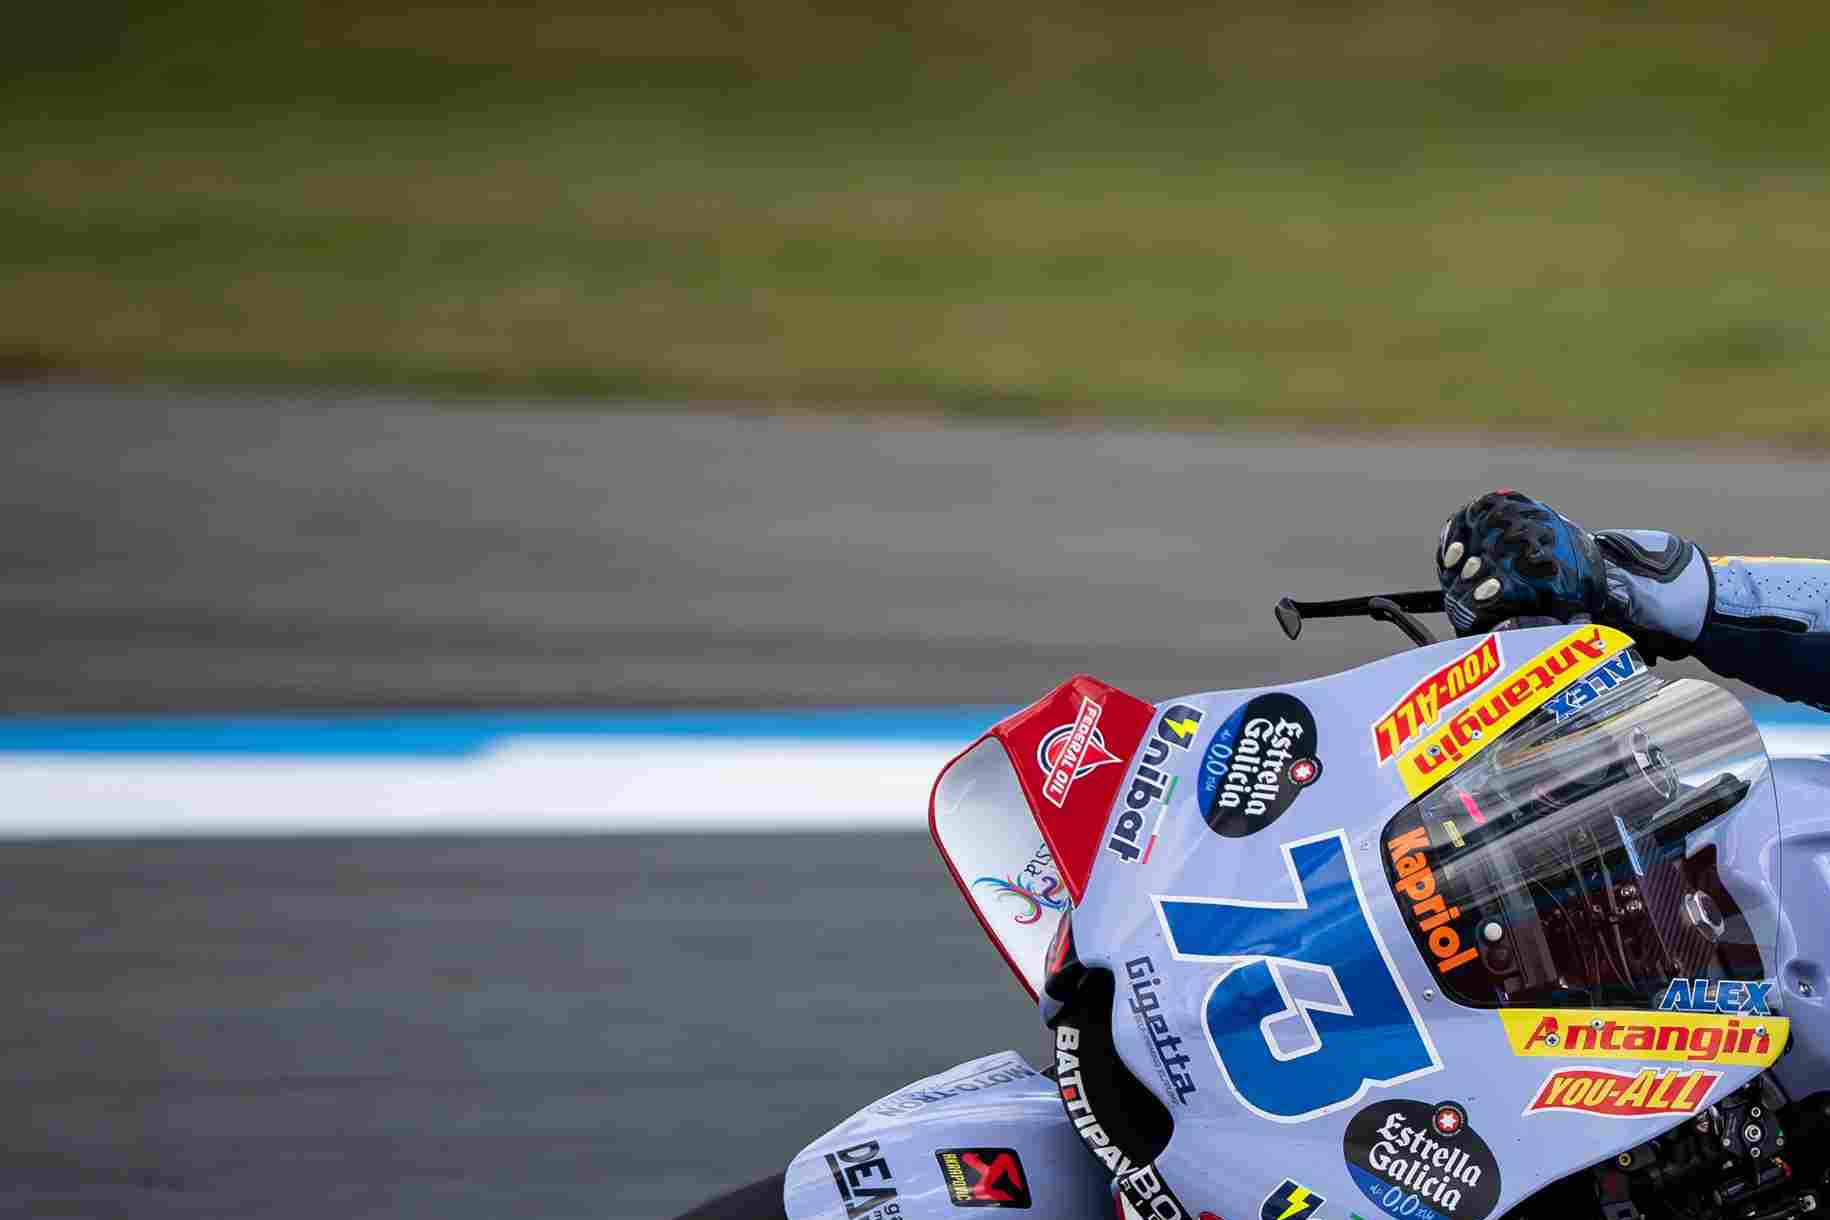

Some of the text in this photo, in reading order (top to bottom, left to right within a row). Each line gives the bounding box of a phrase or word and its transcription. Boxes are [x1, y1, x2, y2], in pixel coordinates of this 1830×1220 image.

[1378, 644, 1499, 755] YOU-ALL
[1413, 629, 1606, 775] Antangin
[1049, 707, 1098, 797] FEDERAL OIL
[1105, 703, 1206, 863] Unibat
[1218, 717, 1274, 809] Galicia
[1247, 716, 1304, 815] Estrella
[1387, 826, 1479, 974] Kapriol
[1150, 828, 1445, 1123] 73
[1659, 977, 1776, 1016] ALEX
[1125, 956, 1196, 1106] Gigetta
[1524, 1016, 1771, 1063] Antangin
[1546, 1070, 1706, 1112] YOU-ALL
[1368, 1141, 1463, 1212] Galicia
[1376, 1111, 1483, 1188] Estrella
